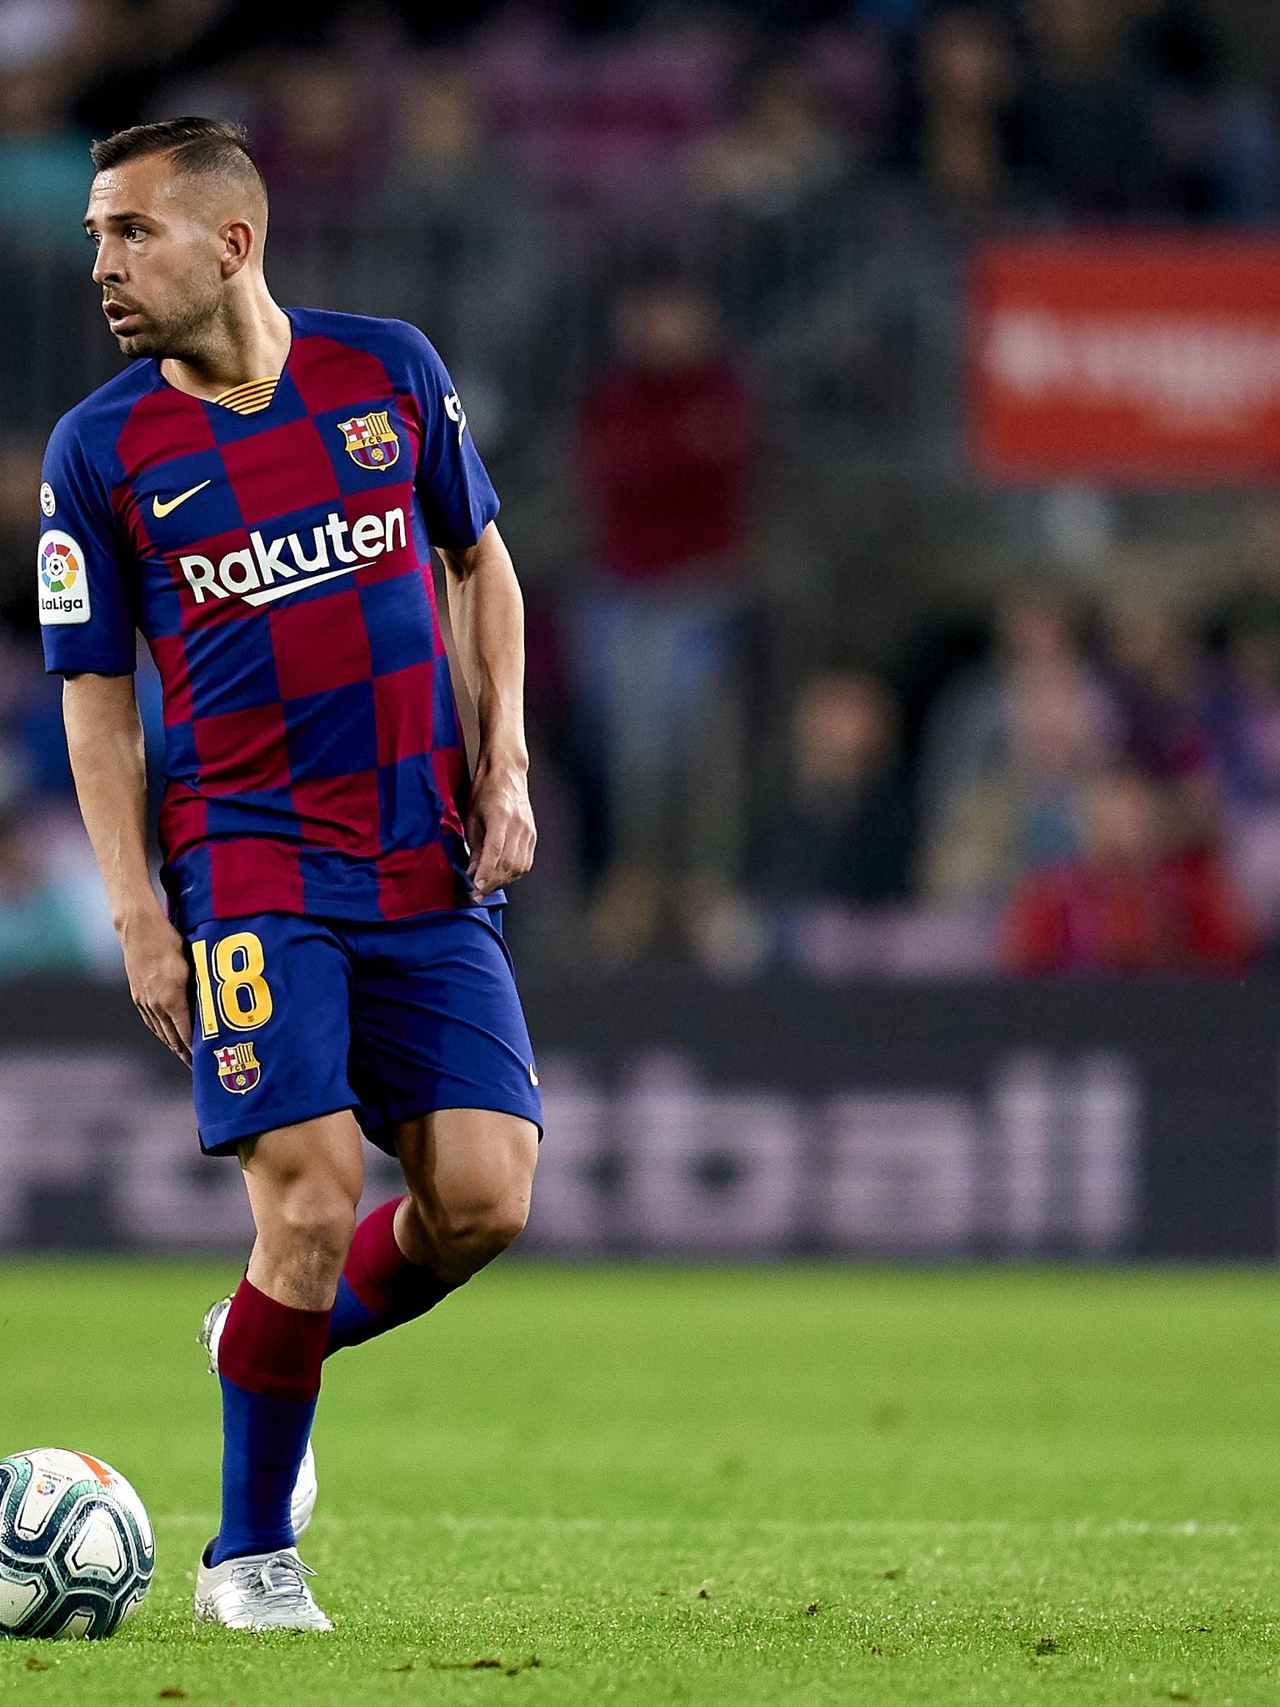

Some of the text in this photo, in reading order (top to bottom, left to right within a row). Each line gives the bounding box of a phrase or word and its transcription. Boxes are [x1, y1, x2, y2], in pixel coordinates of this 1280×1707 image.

[361, 436, 383, 446] FCB
[180, 507, 407, 604] Rakuten
[191, 931, 274, 1041] 18
[229, 1064, 247, 1073] FCB
